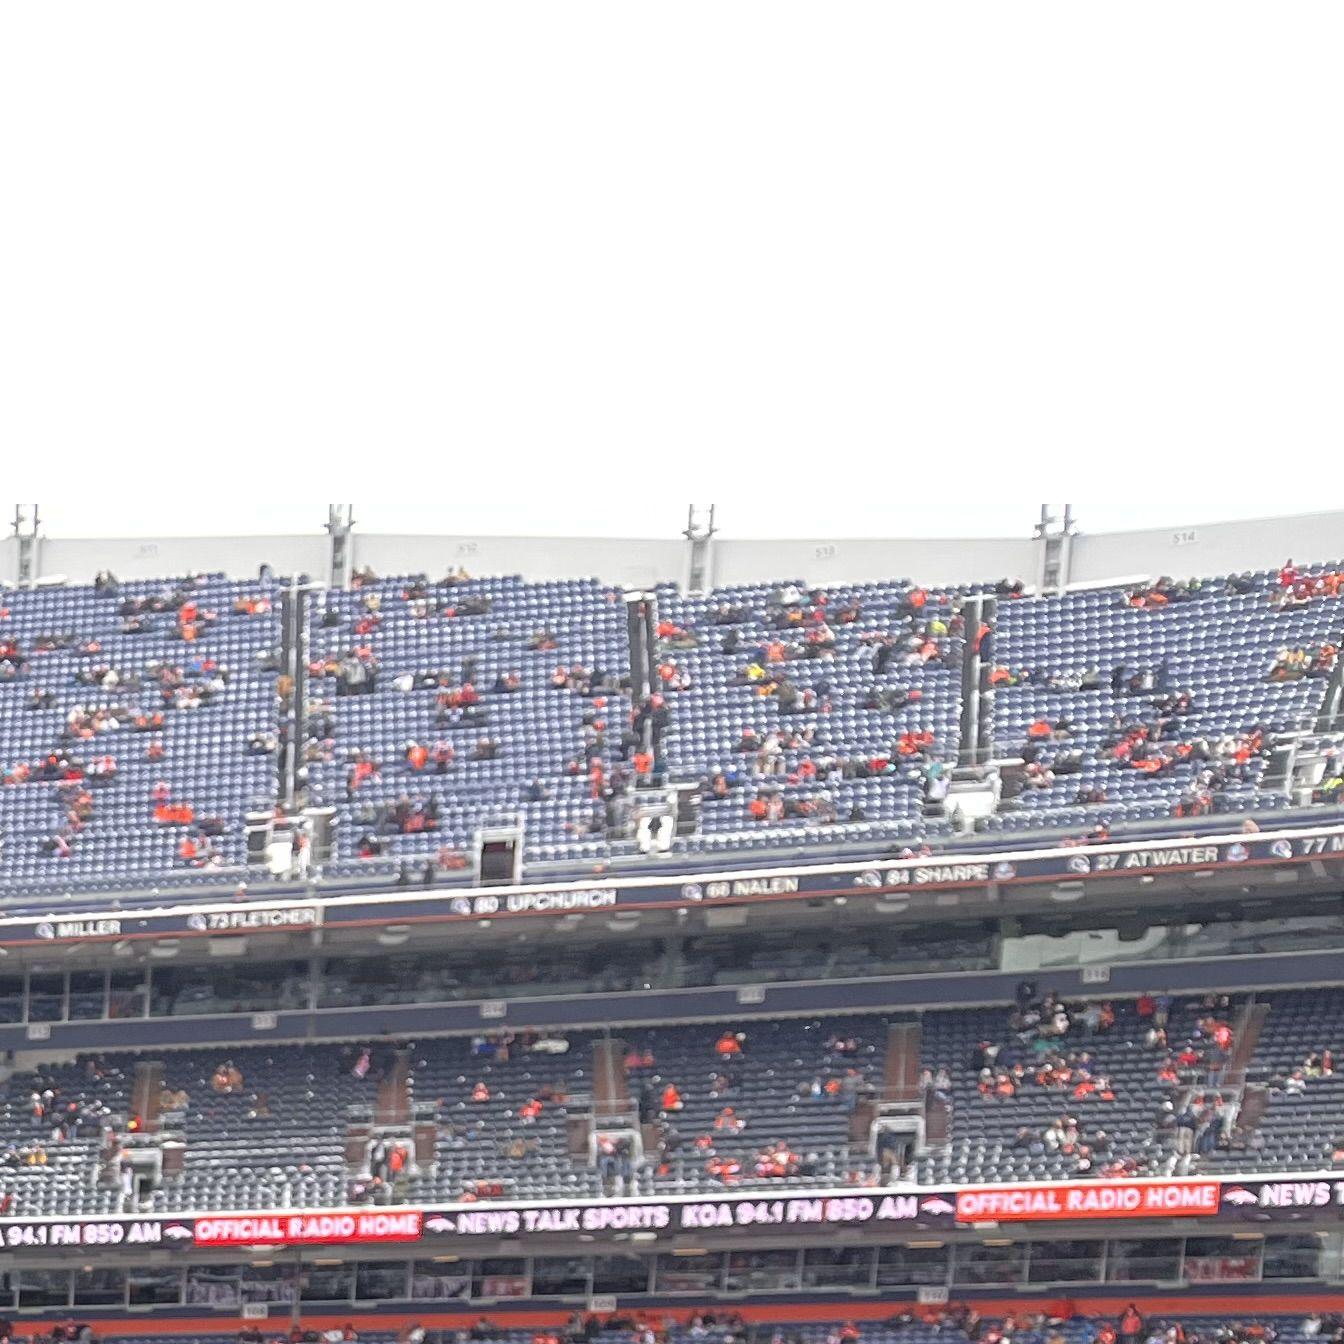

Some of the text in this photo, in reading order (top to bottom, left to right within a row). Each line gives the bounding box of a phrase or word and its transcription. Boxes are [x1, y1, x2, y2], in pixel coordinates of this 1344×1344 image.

[1302, 837, 1328, 854] 77
[1124, 847, 1218, 868] ATWATER
[915, 863, 988, 884] SHARPE
[733, 877, 799, 896] NALEN
[507, 888, 617, 911] UPCHURCH
[230, 908, 315, 926] FLETCHER
[57, 920, 121, 937] MILLER
[958, 1186, 1216, 1213] OFFICIAL RADIO HOME
[1258, 1183, 1331, 1206] NEWS
[457, 1206, 670, 1233] NEWS TALK SPORTS
[680, 1197, 918, 1226] KOA 94.1 FM 850 AM
[7, 1226, 48, 1245] 94.1
[50, 1225, 80, 1244] FM
[82, 1224, 124, 1243] 850
[128, 1223, 162, 1242] AM
[195, 1214, 420, 1238] OFFICIAL RADIO HOME
